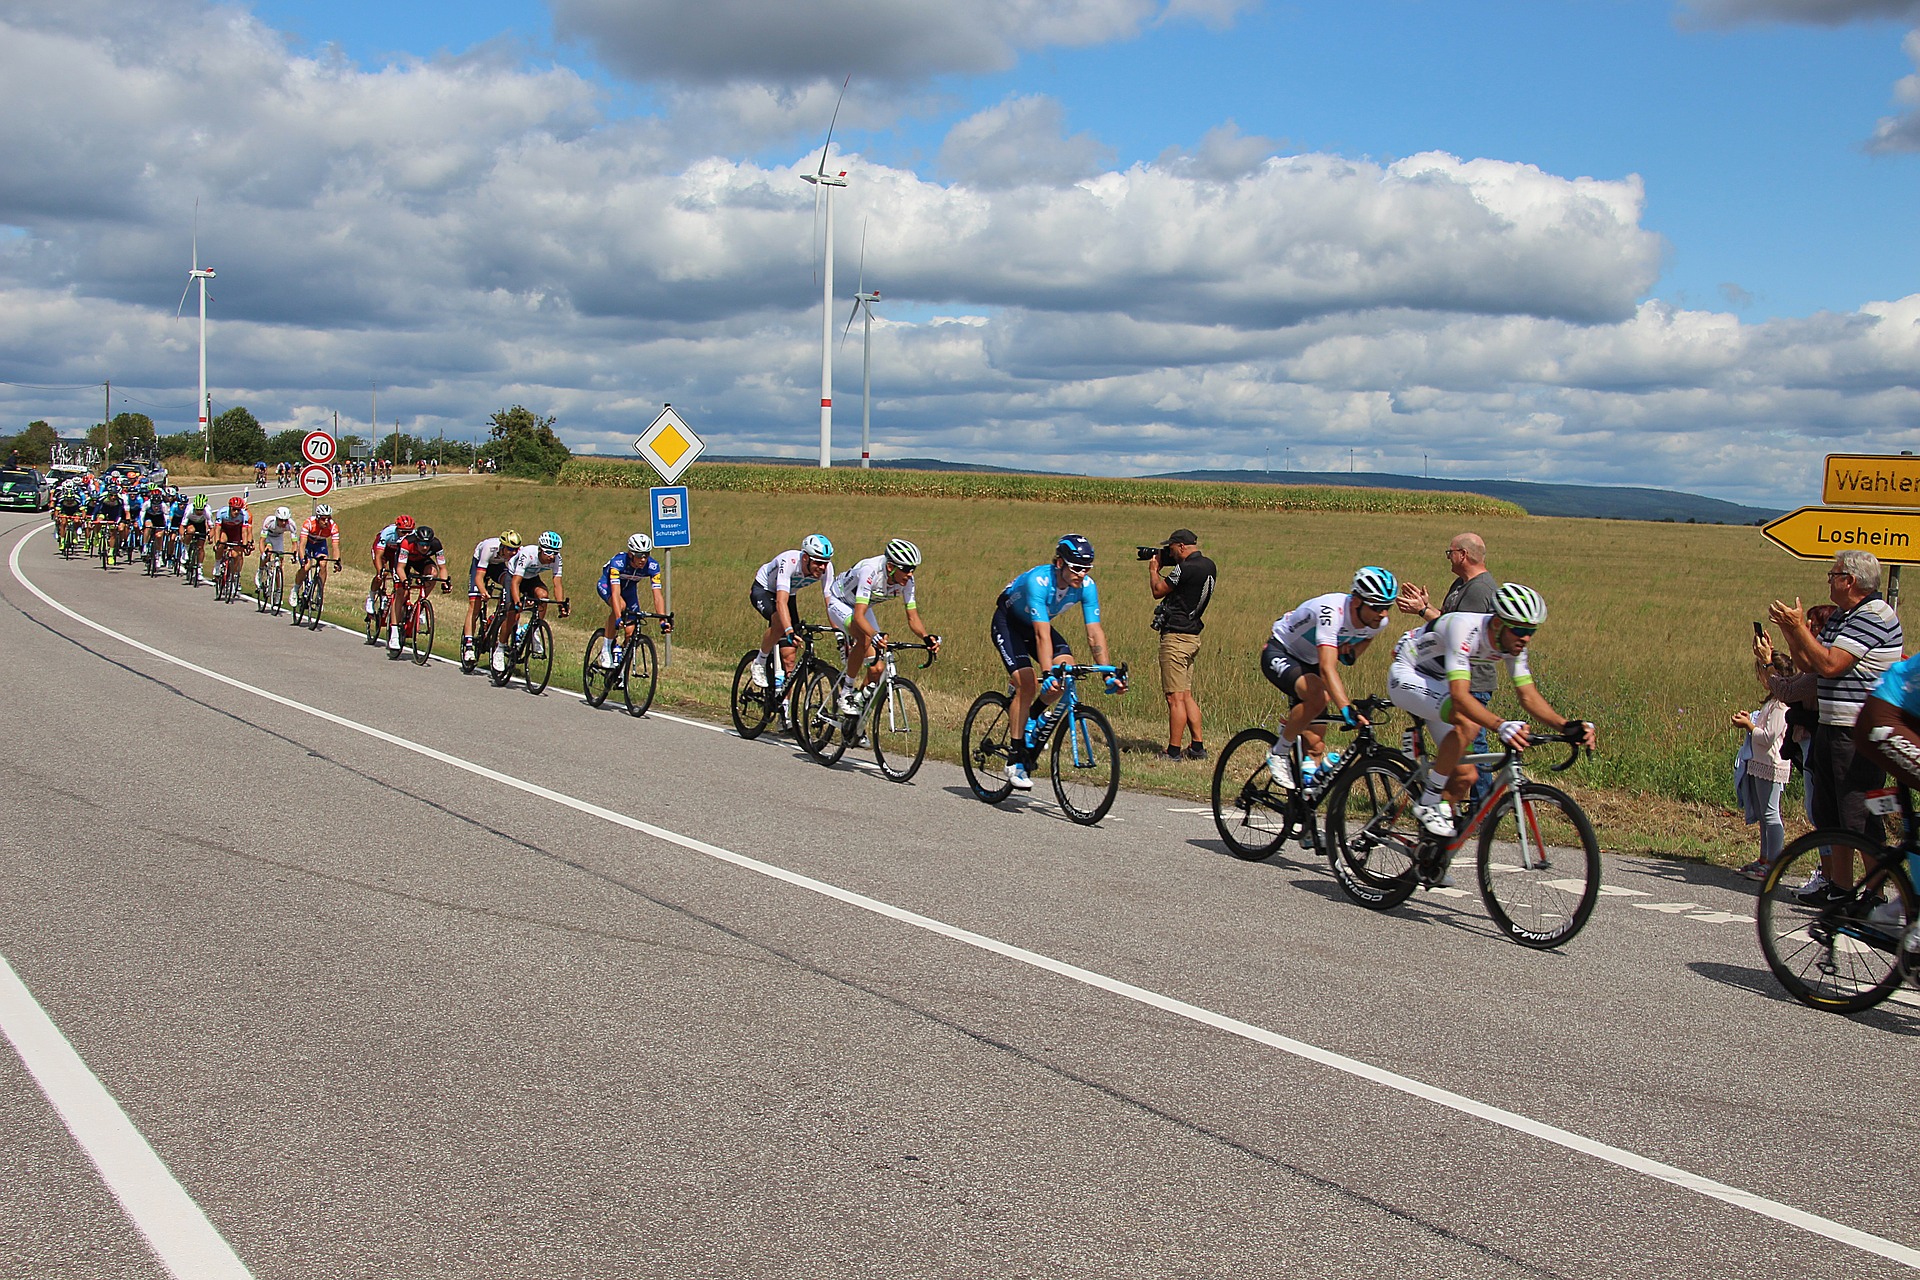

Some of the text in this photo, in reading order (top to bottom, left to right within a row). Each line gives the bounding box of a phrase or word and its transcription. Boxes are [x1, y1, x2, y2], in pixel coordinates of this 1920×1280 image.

[311, 441, 329, 456] 70
[1817, 524, 1909, 546] Losheim
[1037, 702, 1067, 743] CANYON
